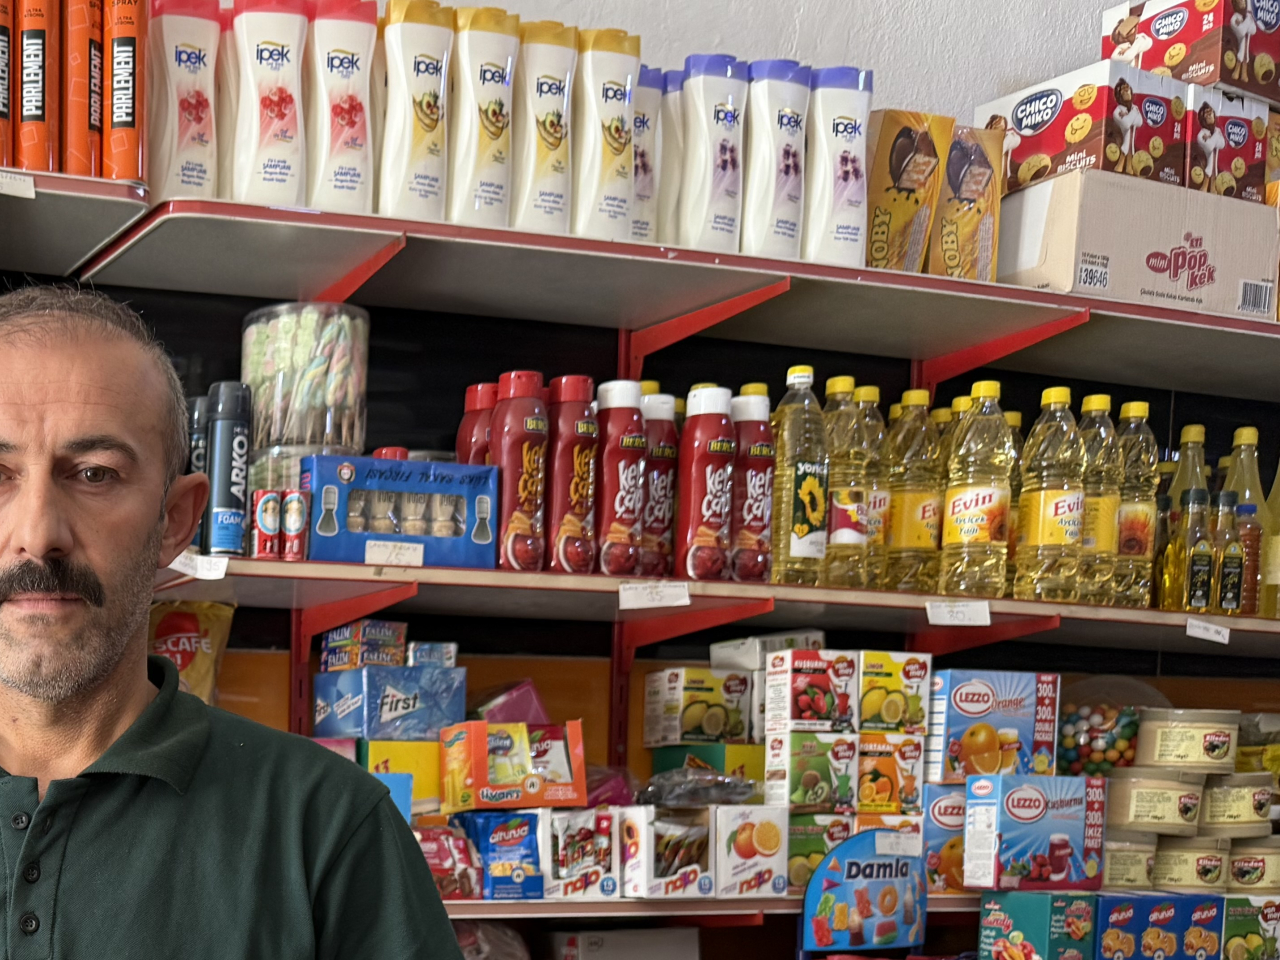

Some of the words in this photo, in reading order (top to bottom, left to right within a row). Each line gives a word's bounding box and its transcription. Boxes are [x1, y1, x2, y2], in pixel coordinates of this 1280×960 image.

[1156, 11, 1185, 30] CHICO
[1202, 12, 1214, 24] 24
[1257, 9, 1277, 24] MIKO
[1159, 20, 1182, 35] MIKO
[175, 44, 207, 68] ipek
[256, 44, 291, 65] ipek
[327, 52, 360, 73] ipek
[23, 35, 43, 116] PARLEMENT
[414, 55, 443, 77] ipek
[112, 40, 133, 122] PARLEMENT
[536, 77, 566, 98] ipek
[714, 104, 740, 128] ipek
[1016, 94, 1057, 118] CHICO
[1144, 101, 1165, 116] CHICO
[1146, 111, 1162, 122] MIKO
[778, 109, 802, 132] ipek
[832, 117, 861, 138] ipek
[1021, 108, 1053, 128] MIKO
[1148, 256, 1168, 268] mini
[1170, 247, 1208, 281] pop
[1082, 268, 1108, 288] 39646
[230, 434, 248, 502] ARKO
[950, 490, 994, 517] Evin
[218, 514, 242, 525] FOAM
[380, 692, 418, 713] First
[958, 692, 990, 703] LEZZO
[1010, 798, 1042, 809] LEZZO
[844, 858, 909, 882] Damla
